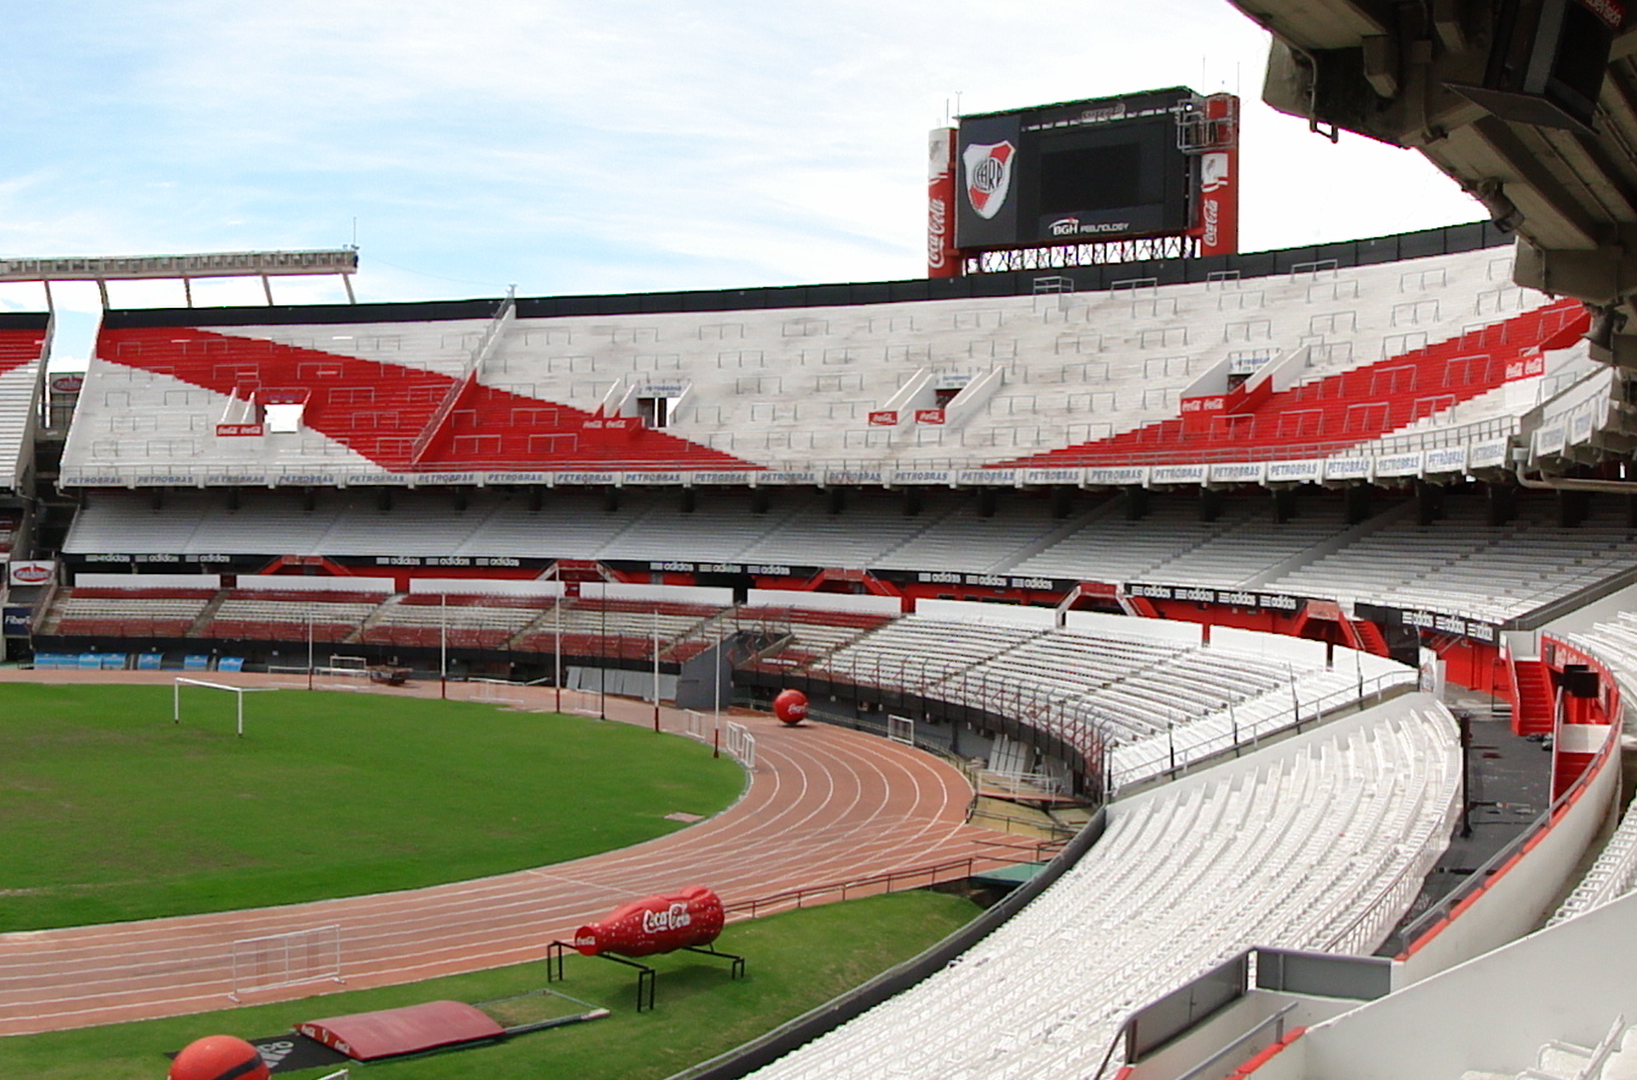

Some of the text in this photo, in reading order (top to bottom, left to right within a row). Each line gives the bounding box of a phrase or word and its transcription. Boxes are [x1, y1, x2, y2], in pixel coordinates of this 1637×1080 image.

[1054, 222, 1078, 236] BGH
[1328, 461, 1370, 475] PETROBRAS
[1378, 456, 1419, 470] PETROBRAS
[1091, 470, 1142, 480] PETROBRAS
[1155, 468, 1203, 479] PETROBRAS
[1213, 466, 1260, 478] PETROBRAS
[1271, 464, 1317, 476] PETROBRAS
[962, 472, 1014, 481] PETROBRAS
[1029, 472, 1079, 481] PETROBRAS
[200, 554, 229, 563] adidas
[391, 557, 420, 565] adidas
[440, 557, 470, 566] adidas
[490, 558, 519, 567] adidas
[665, 562, 693, 571] adidas
[761, 565, 790, 575] adidas
[979, 575, 1007, 586] adidas
[1143, 586, 1171, 598] adidas
[1188, 588, 1214, 602] adidas
[1230, 592, 1255, 606] adidas
[1271, 595, 1296, 610] adidas
[642, 903, 691, 934] Coca-Cola
